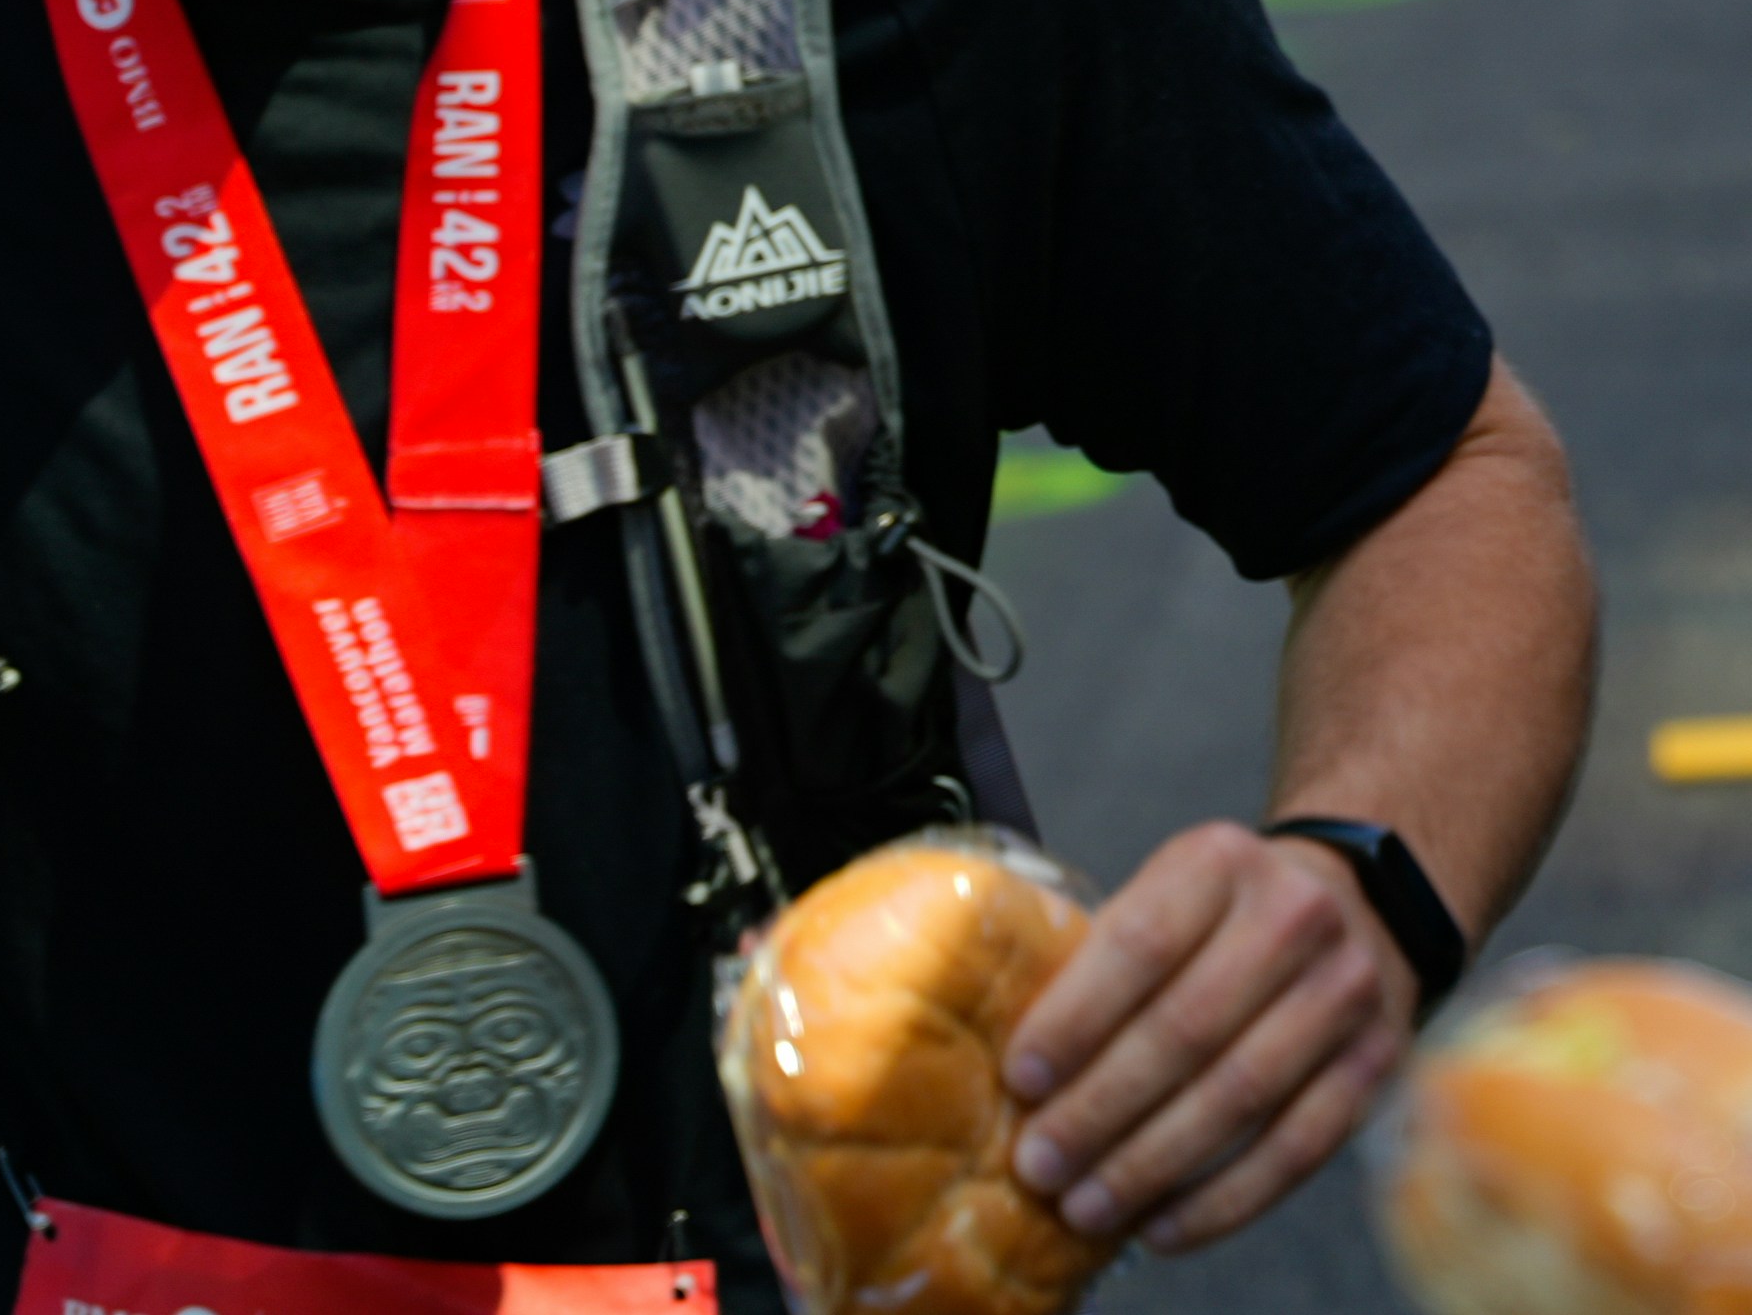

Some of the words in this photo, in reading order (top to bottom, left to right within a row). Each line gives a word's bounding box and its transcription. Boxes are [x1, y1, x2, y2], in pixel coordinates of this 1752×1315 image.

[108, 35, 169, 133] BMO
[431, 69, 502, 178] RAN
[679, 260, 848, 323] AONIJIE
[195, 304, 300, 424] RAN
[311, 596, 402, 769] Vancouver
[351, 596, 438, 758] Marathon
